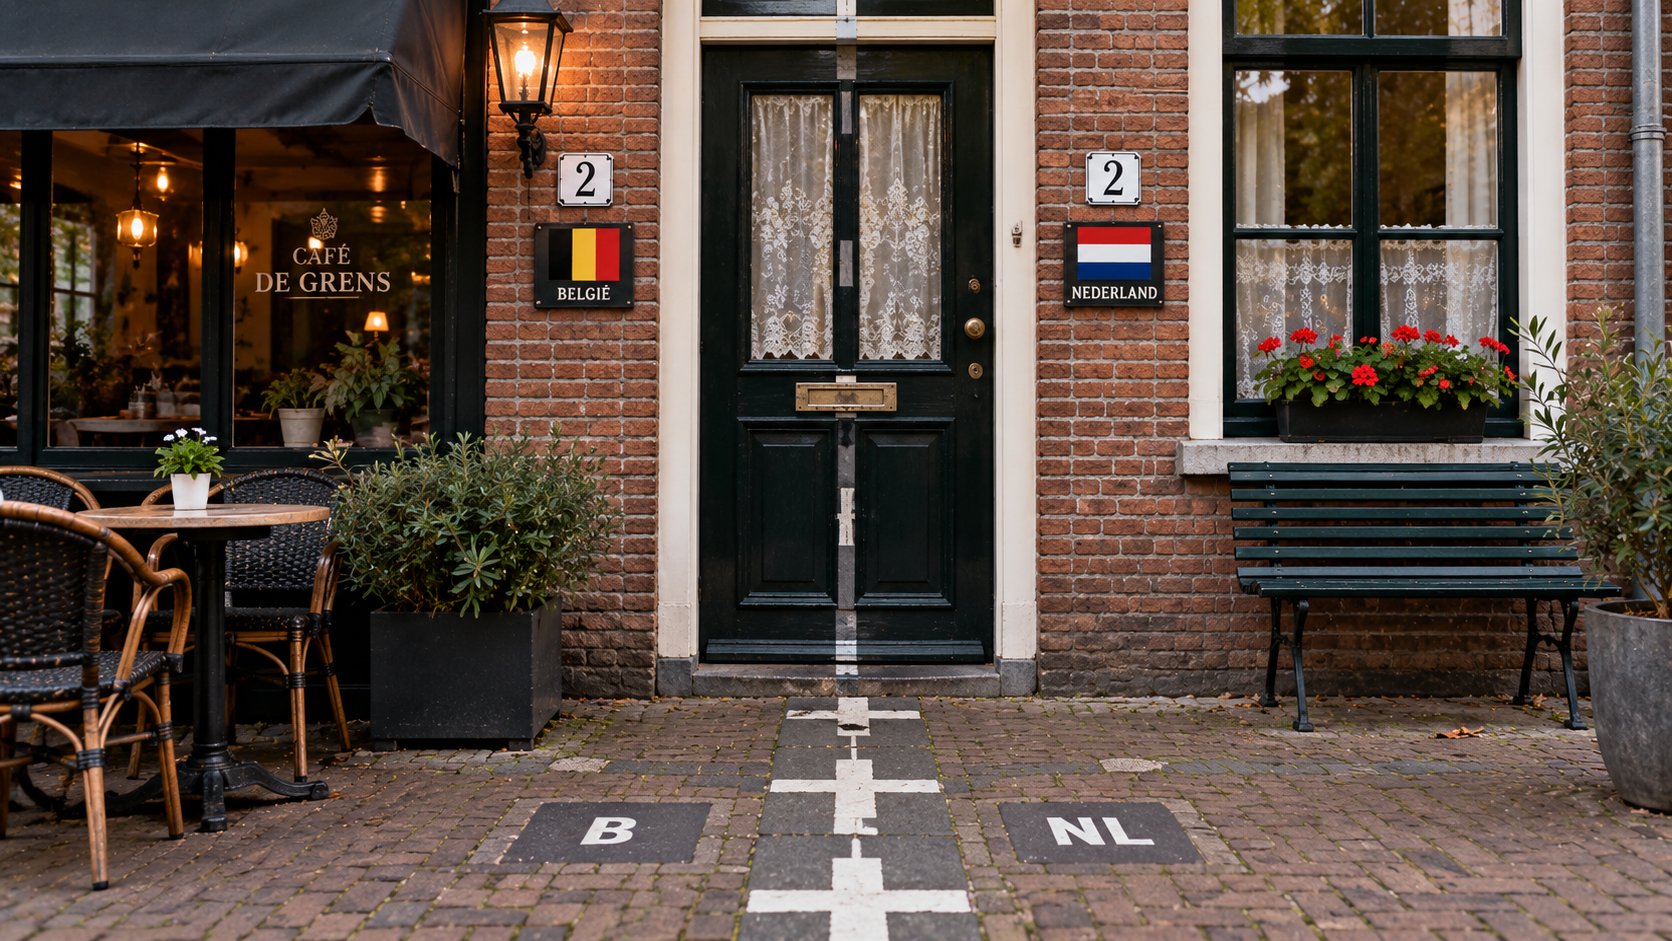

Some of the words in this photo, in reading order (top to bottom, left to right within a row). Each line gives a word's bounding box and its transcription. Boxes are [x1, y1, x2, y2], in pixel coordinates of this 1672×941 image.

[575, 161, 596, 197] 2
[1103, 160, 1124, 196] 2
[292, 243, 351, 266] CAFÉ
[255, 272, 291, 293] DE
[299, 271, 391, 293] GRENS
[1071, 286, 1158, 300] NEDERLAND
[579, 817, 638, 846] B
[1046, 816, 1156, 846] NL
